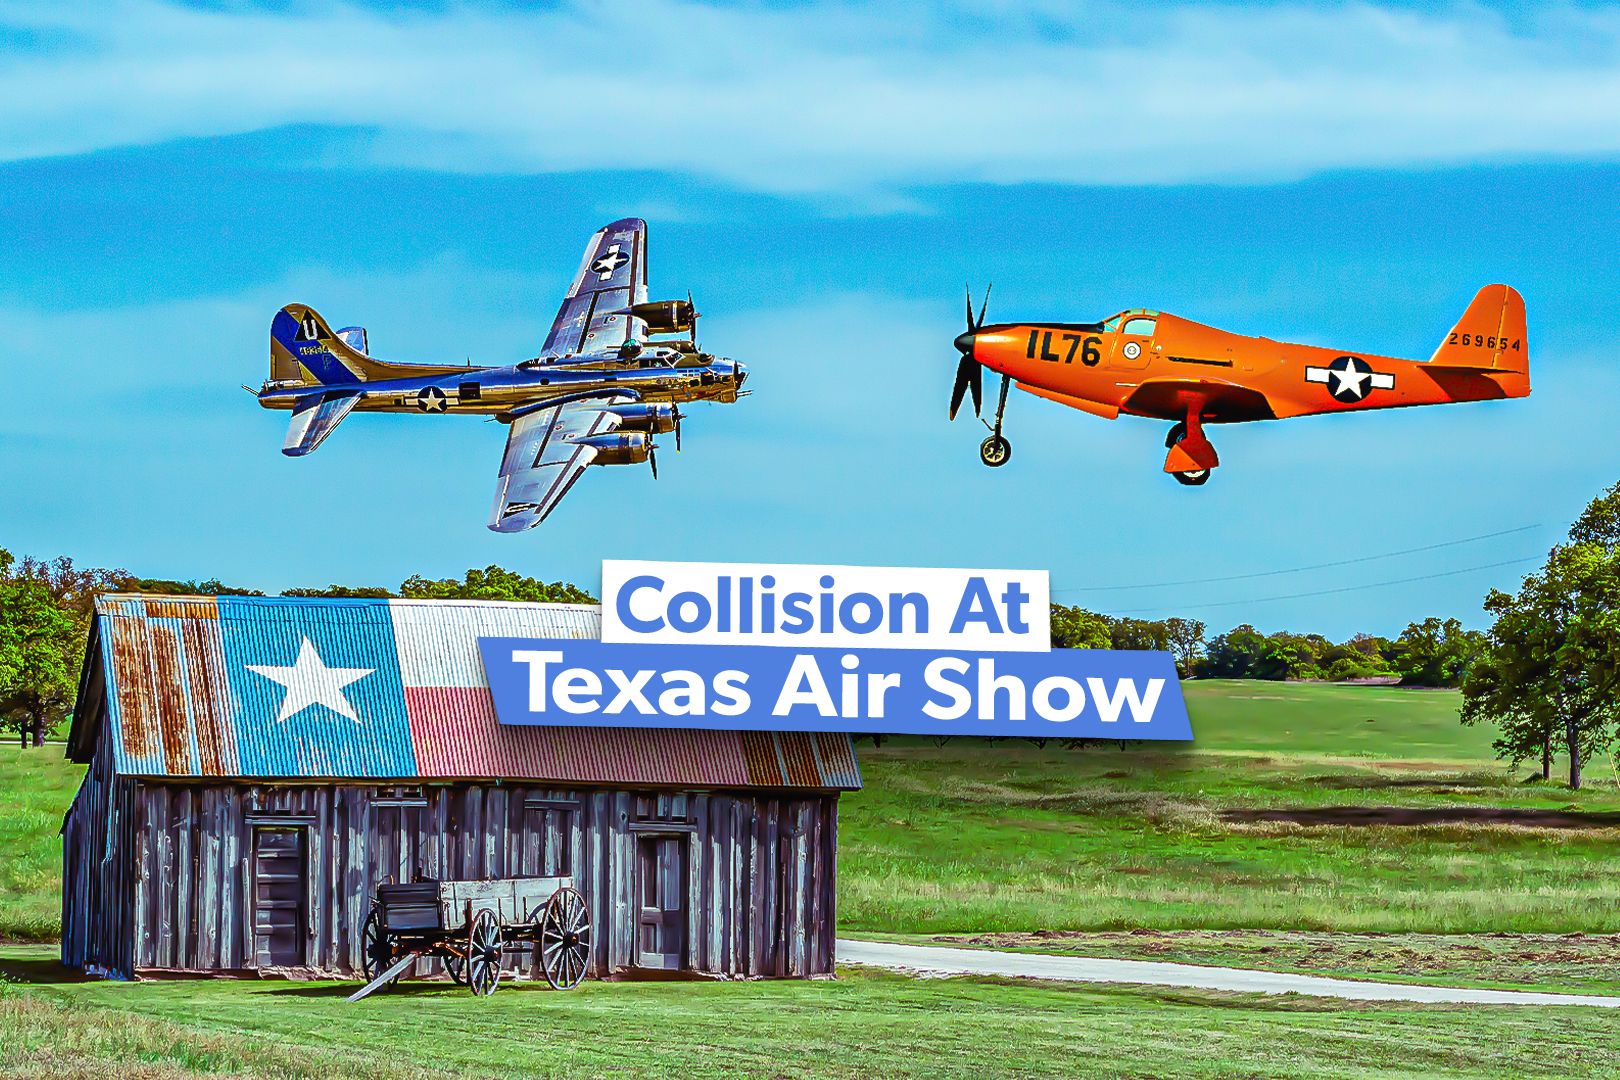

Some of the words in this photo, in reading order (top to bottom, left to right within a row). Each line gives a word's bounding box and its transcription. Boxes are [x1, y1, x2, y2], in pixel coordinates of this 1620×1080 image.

[303, 319, 318, 340] U
[1026, 329, 1103, 367] IL76
[1449, 333, 1521, 352] 269654
